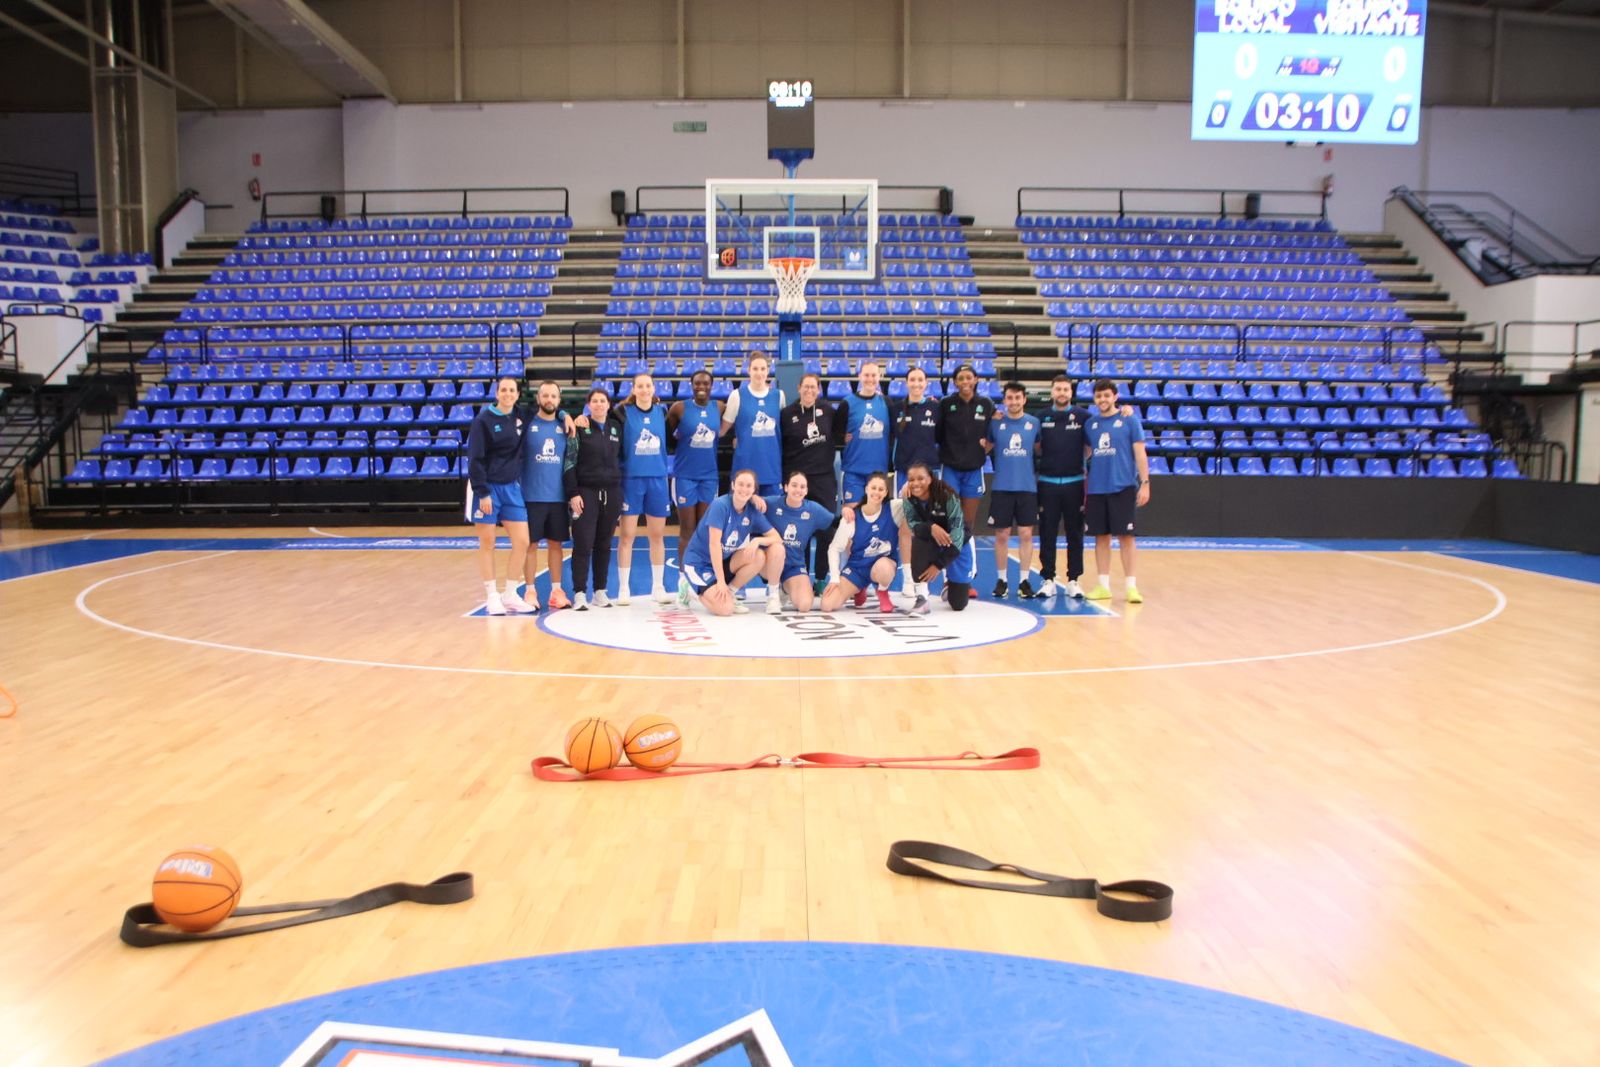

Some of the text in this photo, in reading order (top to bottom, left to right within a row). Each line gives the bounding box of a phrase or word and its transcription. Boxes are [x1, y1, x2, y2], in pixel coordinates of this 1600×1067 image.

[1235, 42, 1259, 80] 0
[1383, 45, 1407, 82] 0
[1254, 91, 1361, 131] 03:10
